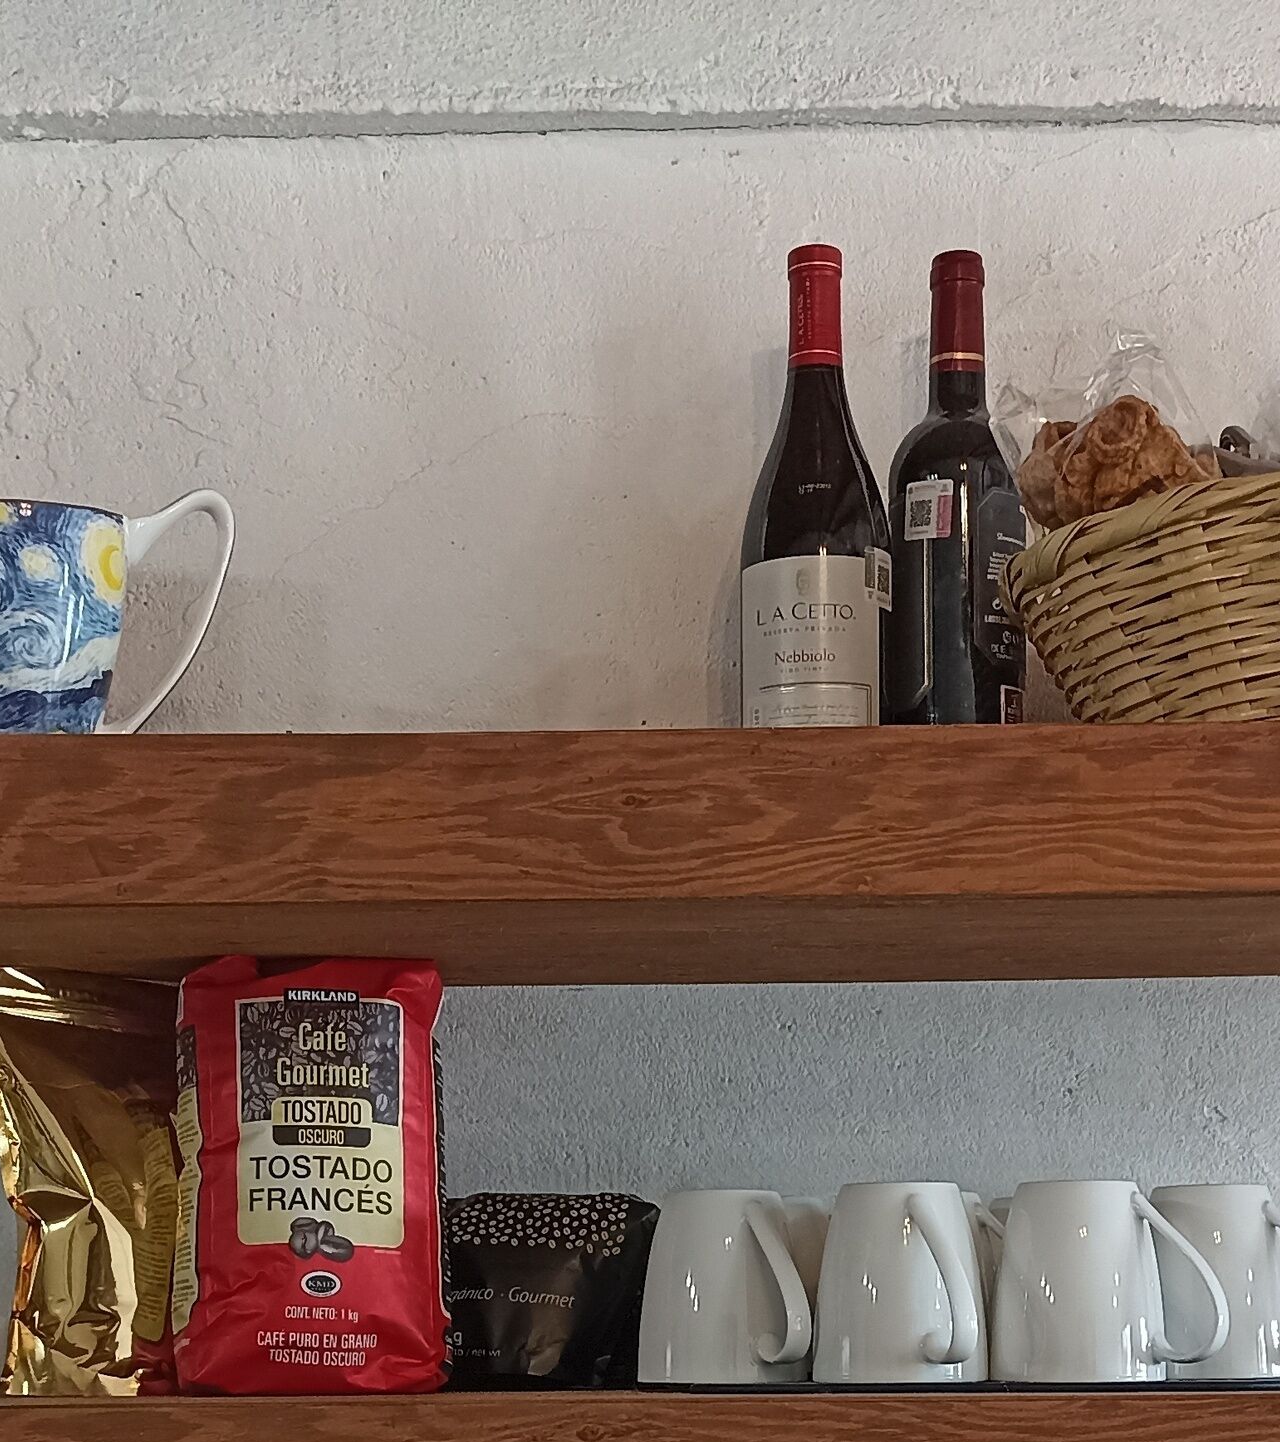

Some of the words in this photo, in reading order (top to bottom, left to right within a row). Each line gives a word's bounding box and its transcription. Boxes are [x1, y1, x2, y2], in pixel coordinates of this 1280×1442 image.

[774, 647, 836, 666] Nebbiolo
[288, 990, 357, 1002] KIRKLAND
[298, 1022, 347, 1051] Café
[276, 1057, 370, 1088] Gourmet
[281, 1100, 362, 1125] TOSTADO
[298, 1128, 345, 1145] OSCURO
[249, 1155, 393, 1184] TOSTADO
[249, 1184, 393, 1215] FRANCÉS
[508, 1286, 576, 1309] Gourmet
[341, 1308, 345, 1320] 1
[348, 1309, 359, 1323] kg
[257, 1330, 285, 1347] CAFÉ
[289, 1332, 320, 1348] PURO
[323, 1333, 338, 1349] EN
[341, 1333, 378, 1349] GRANO
[269, 1348, 320, 1365] TOSTADO
[323, 1351, 366, 1367] OSCURO
